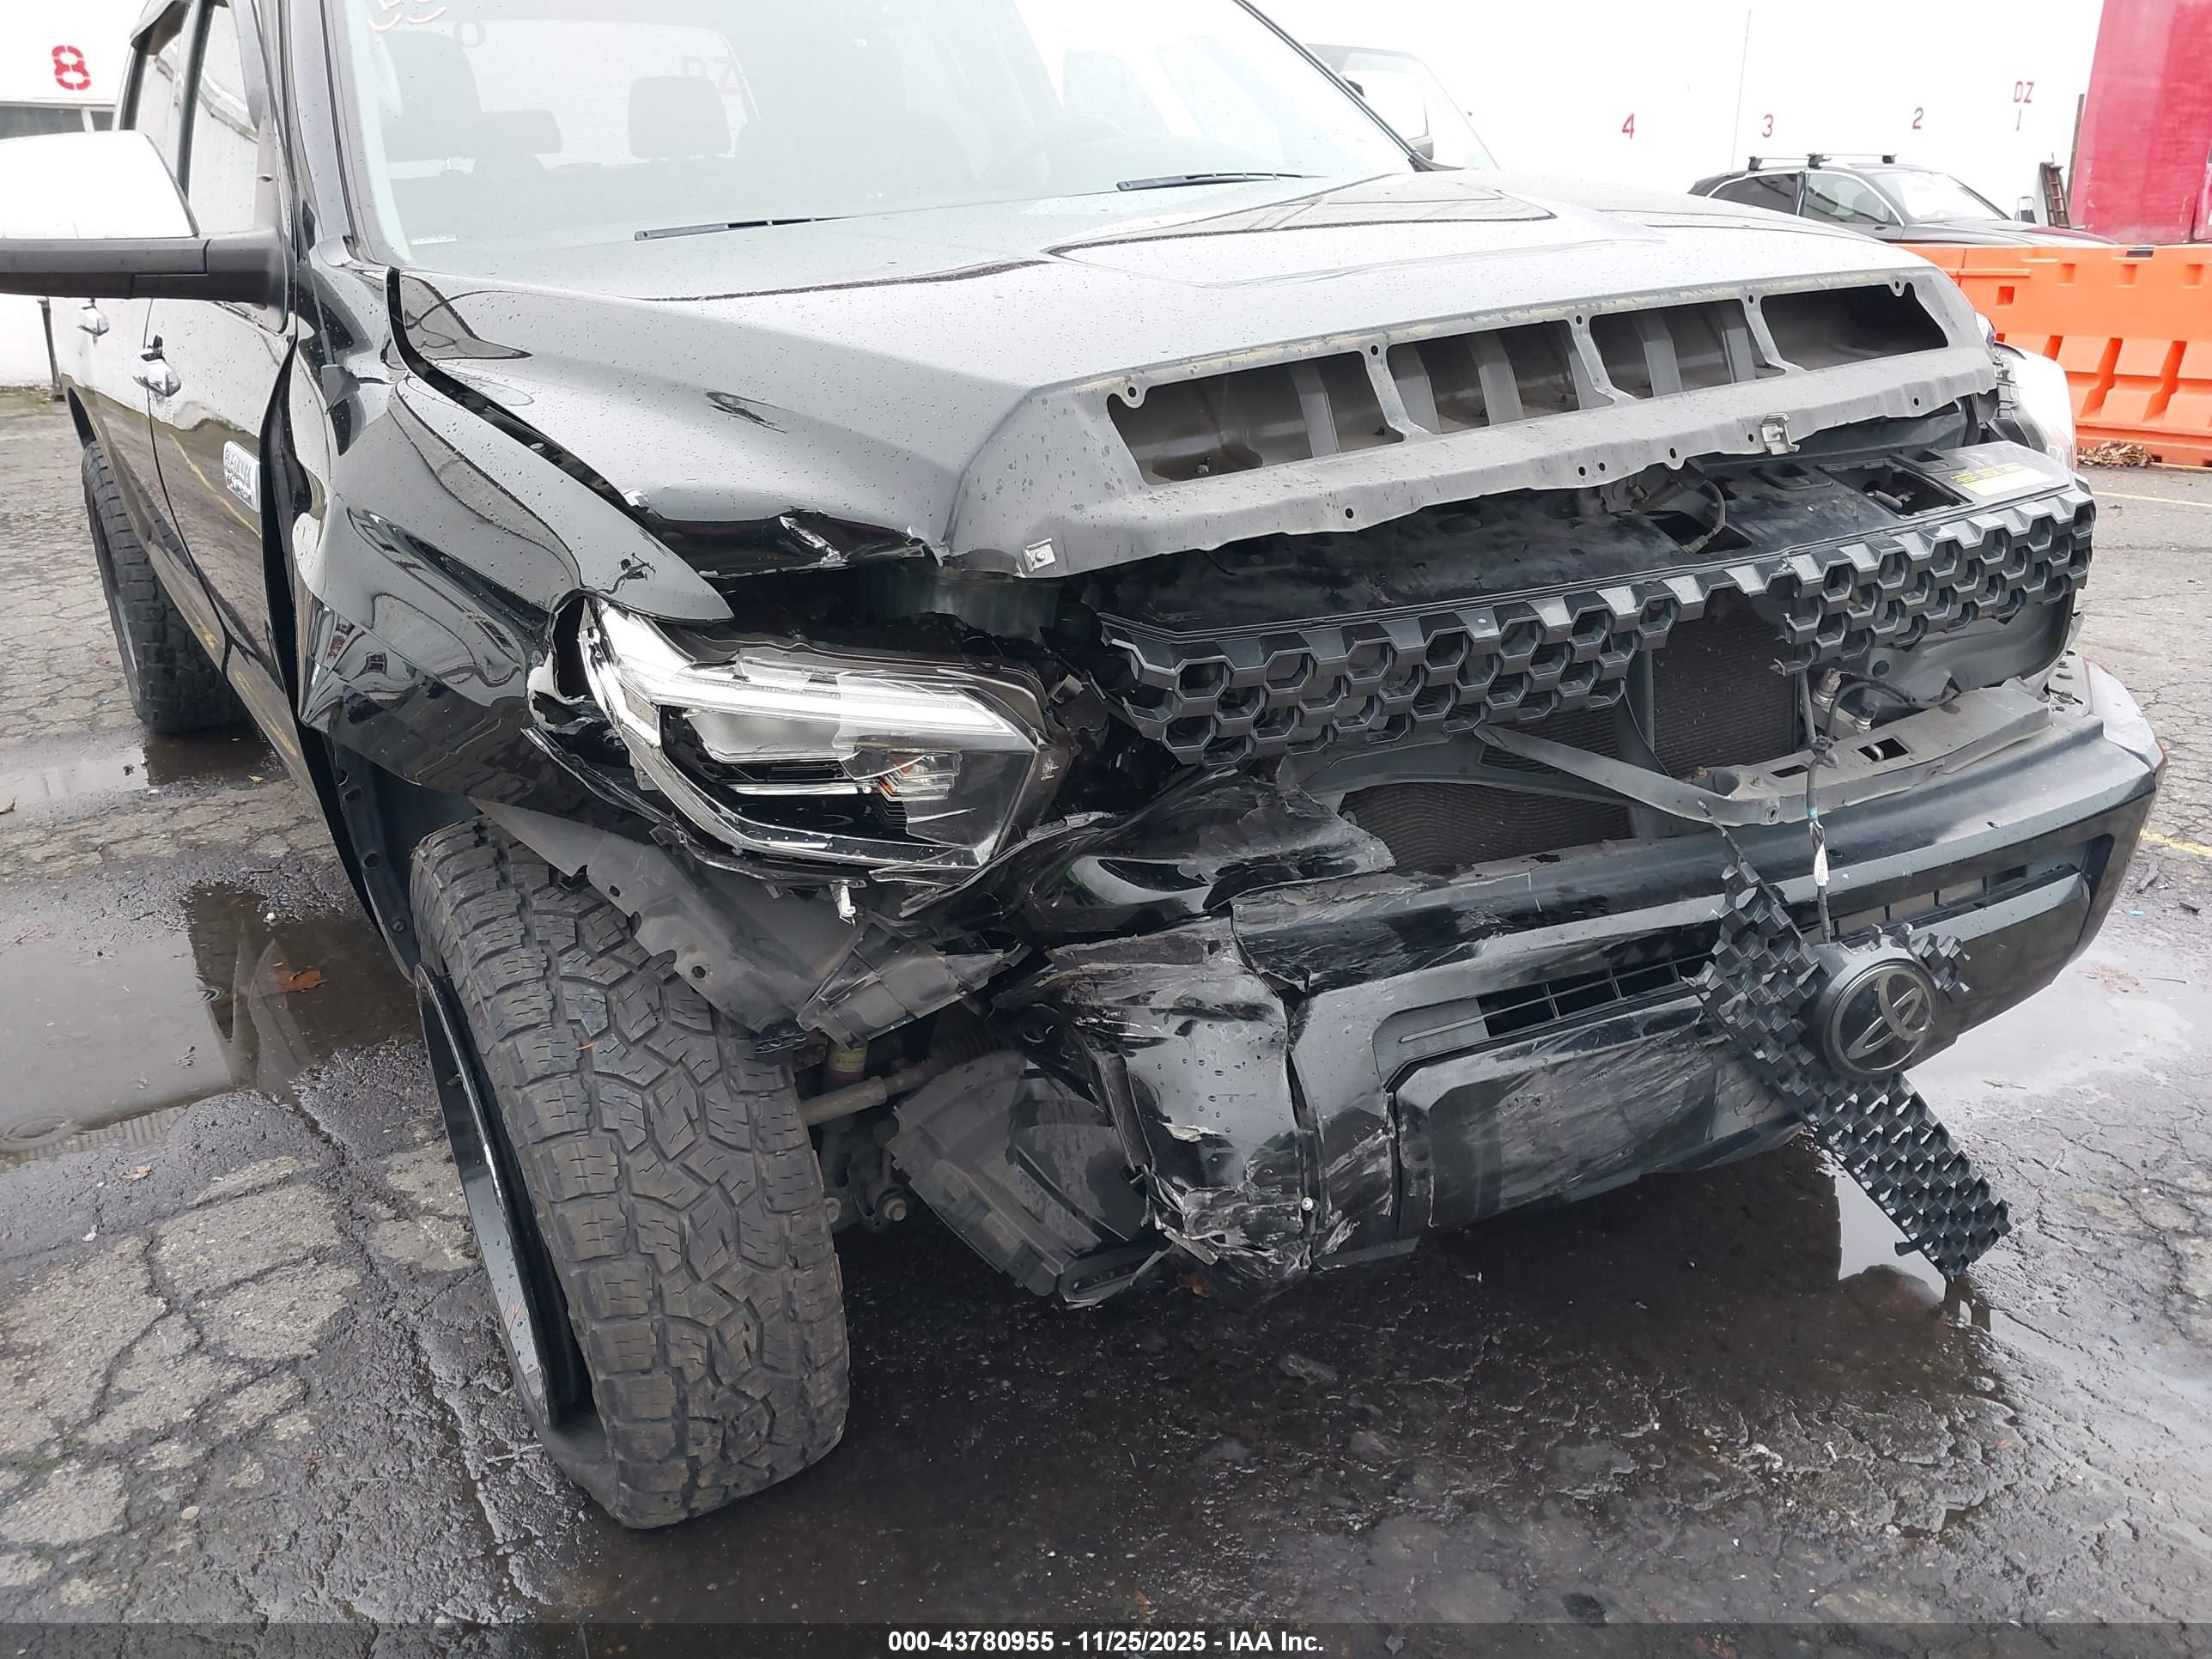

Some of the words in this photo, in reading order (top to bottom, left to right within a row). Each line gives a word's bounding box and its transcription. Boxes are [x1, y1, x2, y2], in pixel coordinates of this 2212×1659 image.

[52, 45, 91, 91] 8
[2014, 81, 2034, 103] DZ
[1621, 112, 1635, 139] 4
[1762, 113, 1774, 138] 3
[1912, 106, 1923, 130] 2
